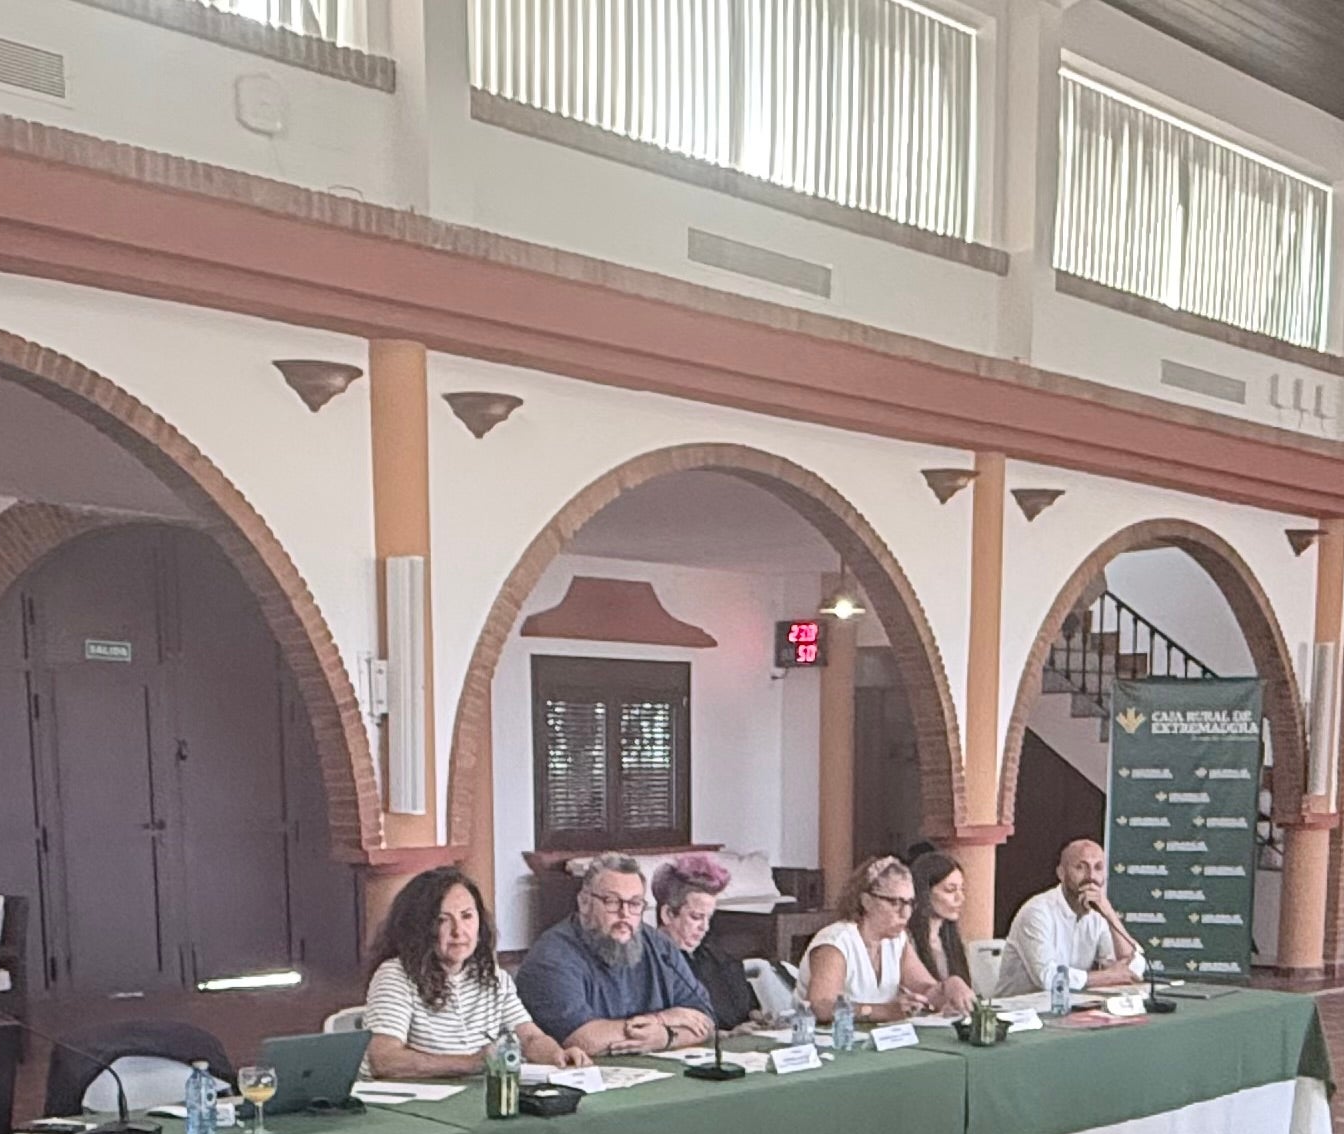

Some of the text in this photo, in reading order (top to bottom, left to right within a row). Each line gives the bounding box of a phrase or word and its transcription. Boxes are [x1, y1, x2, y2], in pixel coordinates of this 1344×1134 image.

[1151, 710, 1253, 722] CAJA RURAL DE
[1151, 722, 1259, 734] EXTREMADURA
